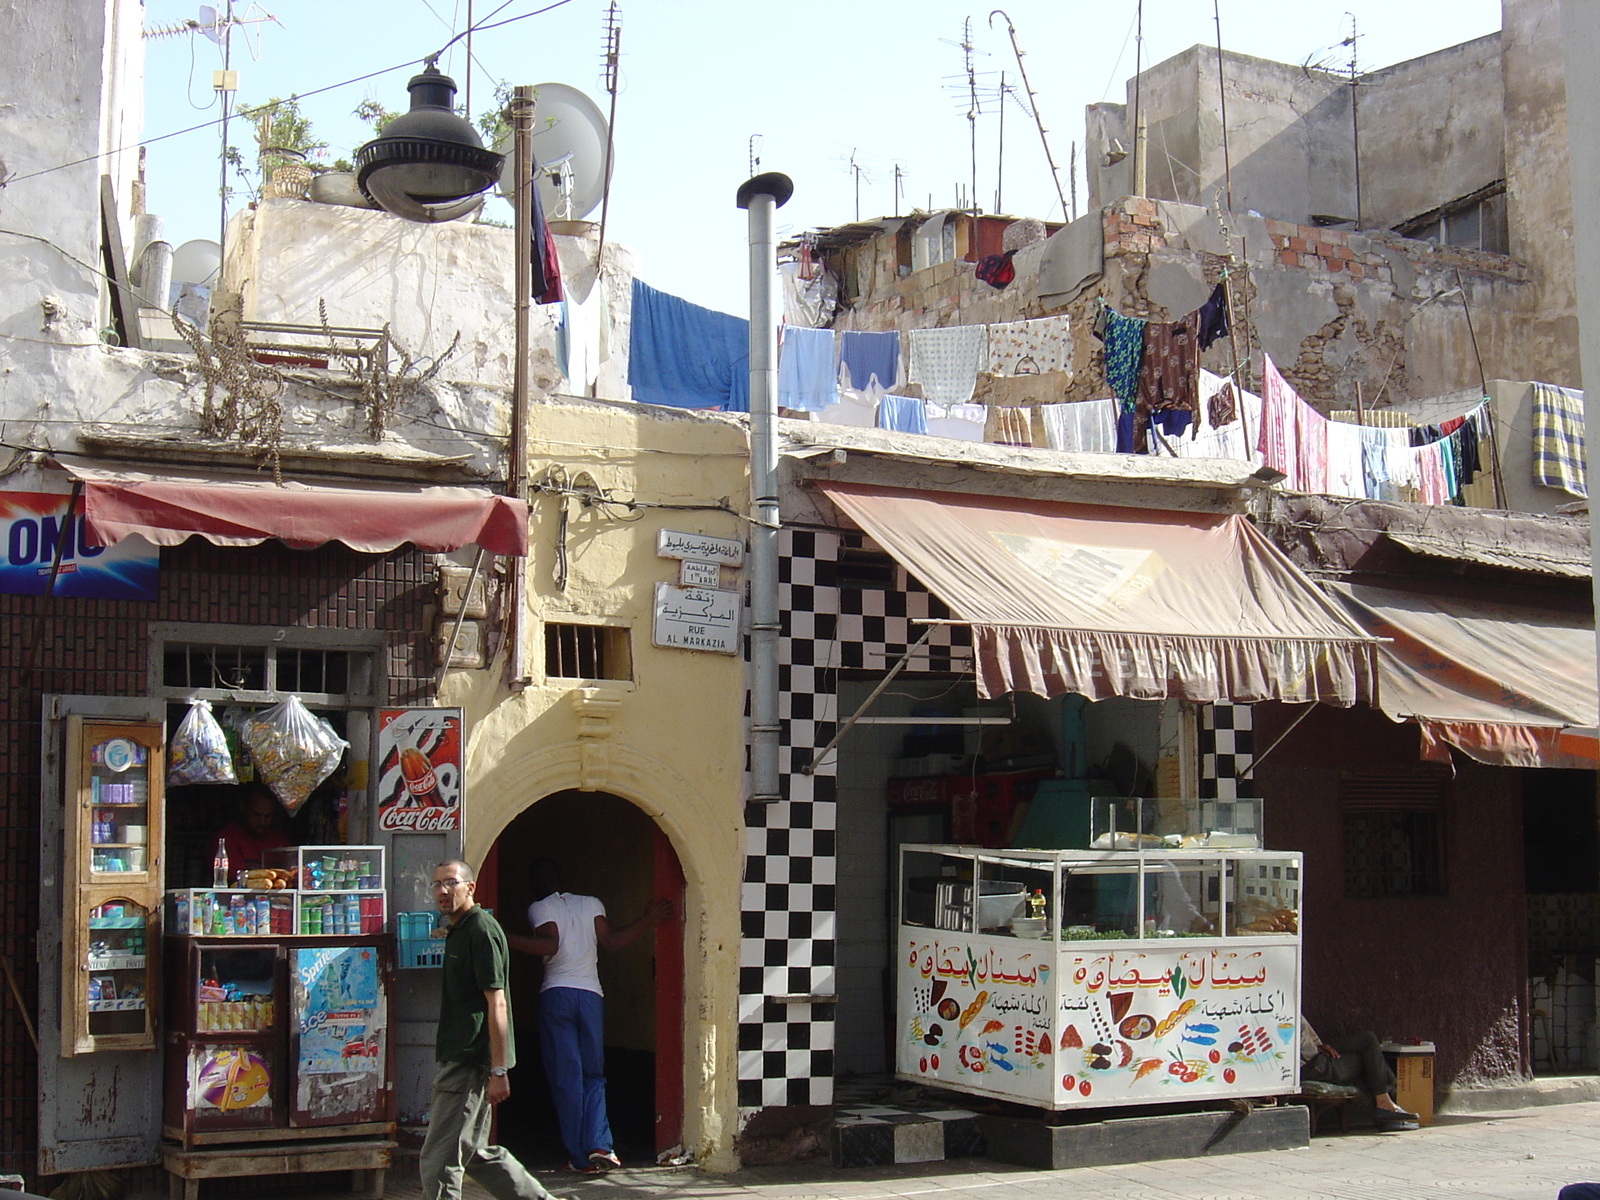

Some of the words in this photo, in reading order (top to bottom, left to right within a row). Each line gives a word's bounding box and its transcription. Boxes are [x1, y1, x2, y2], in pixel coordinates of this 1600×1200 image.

[683, 541, 701, 553] سيدي
[684, 590, 715, 607] زنقة
[662, 602, 734, 621] المركزية
[688, 625, 706, 634] RUE
[666, 634, 678, 643] AL
[683, 636, 726, 648] MARKAZIA
[380, 806, 457, 830] Coca-Cola
[301, 949, 331, 986] Sprite
